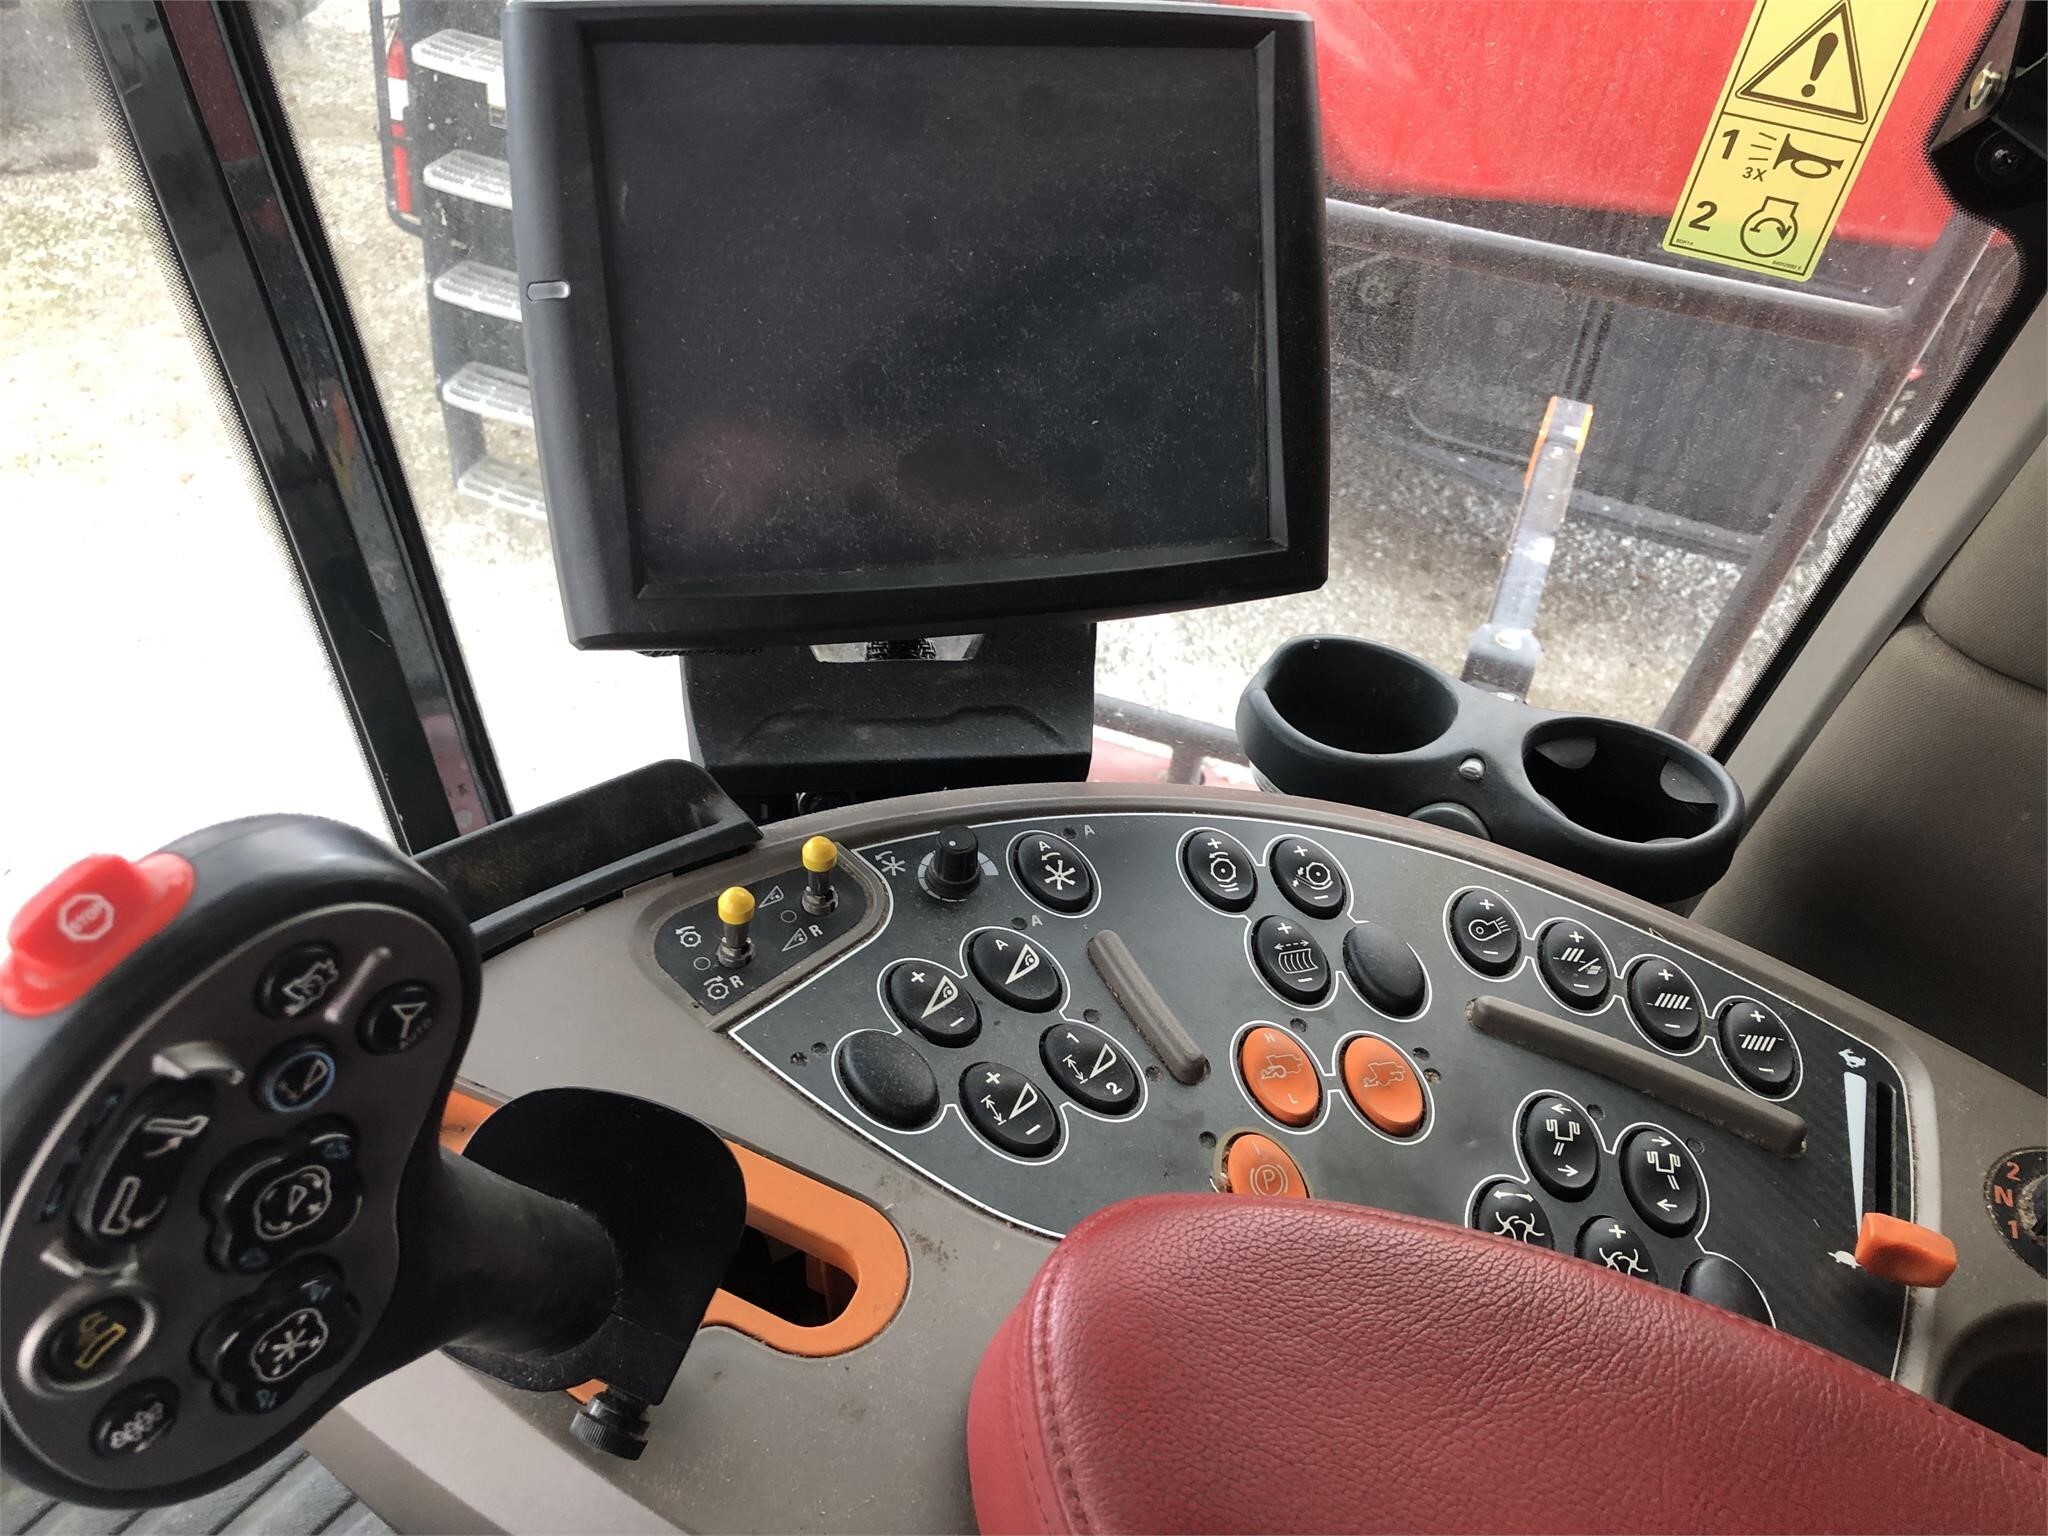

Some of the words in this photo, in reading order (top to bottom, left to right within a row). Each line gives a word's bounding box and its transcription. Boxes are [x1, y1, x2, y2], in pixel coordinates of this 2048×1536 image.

[1722, 129, 1740, 160] 1
[1742, 166, 1767, 182] 3X
[1688, 200, 1718, 232] 2
[1084, 824, 1096, 836] A
[1039, 840, 1052, 852] A
[1031, 914, 1044, 927] A
[808, 924, 824, 938] R
[995, 939, 1009, 951] A
[729, 975, 745, 989] R
[1066, 1032, 1080, 1043] 1
[1263, 1032, 1276, 1043] H
[1105, 1081, 1123, 1095] 2
[2006, 1161, 2021, 1181] 2
[1262, 1169, 1275, 1191] P
[1994, 1184, 2014, 1208] N
[2007, 1220, 2019, 1240] 1
